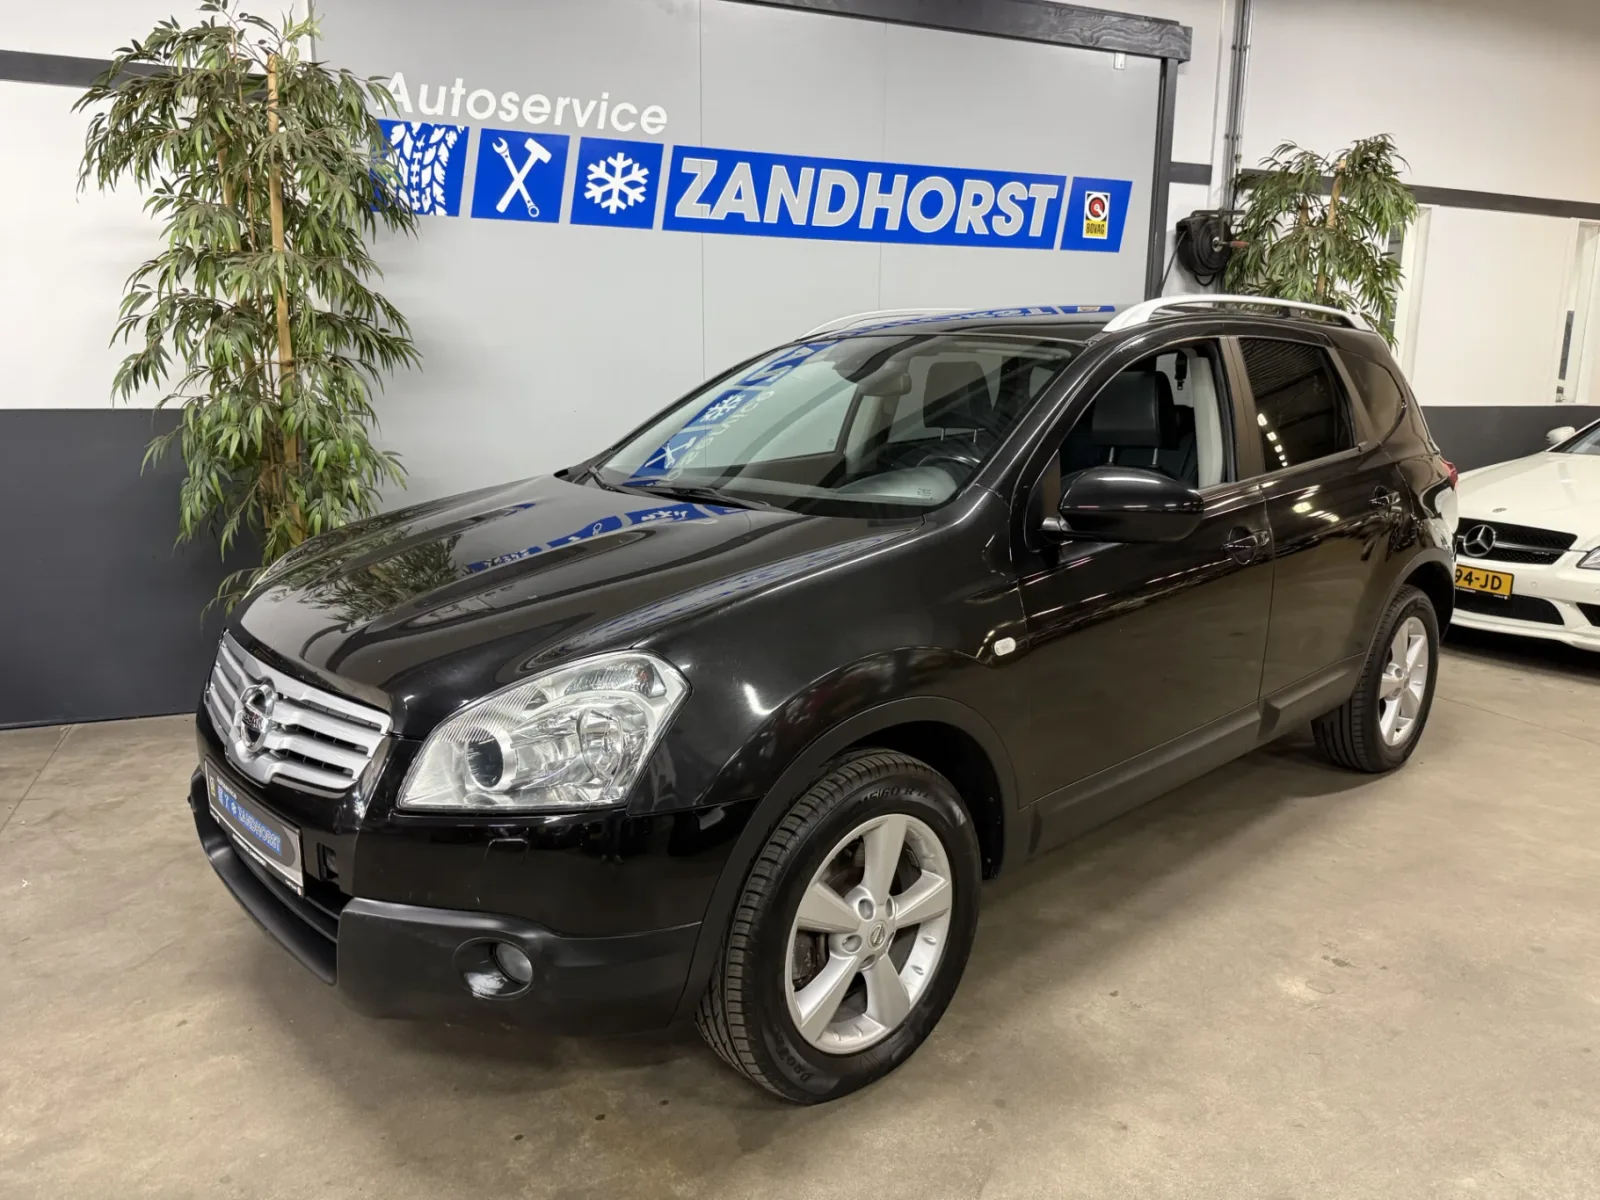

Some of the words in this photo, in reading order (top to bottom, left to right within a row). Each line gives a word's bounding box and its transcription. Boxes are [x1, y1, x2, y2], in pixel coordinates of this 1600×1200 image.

[376, 72, 668, 135] Autoservice
[674, 157, 1059, 237] ZANDHORST
[1086, 222, 1105, 235] BOVAG
[1455, 568, 1502, 591] 94-JD
